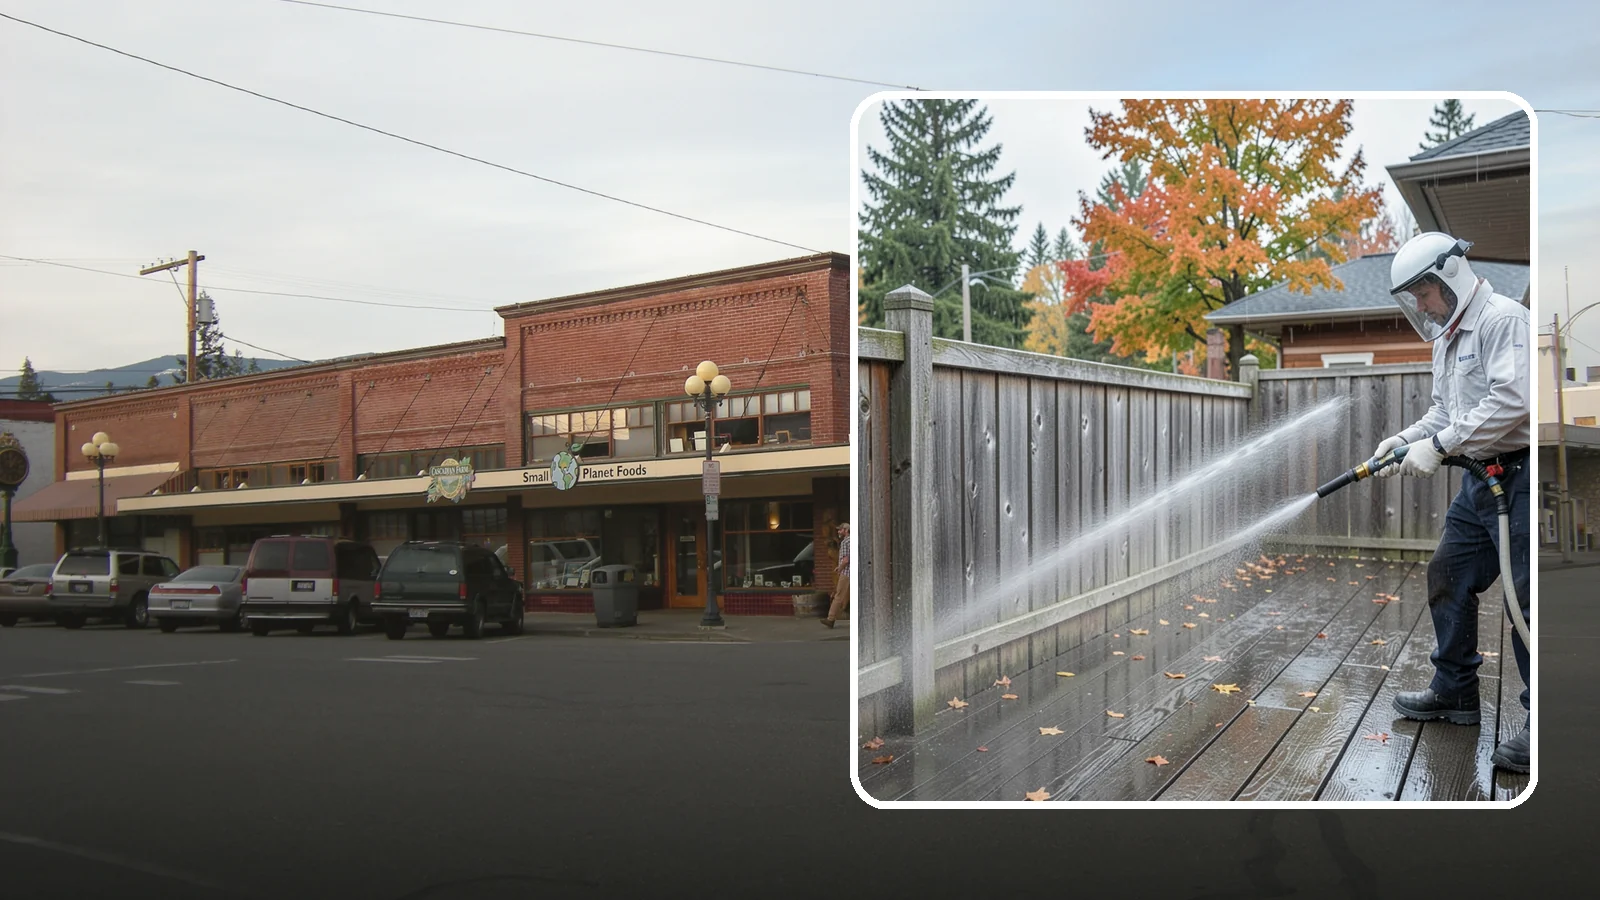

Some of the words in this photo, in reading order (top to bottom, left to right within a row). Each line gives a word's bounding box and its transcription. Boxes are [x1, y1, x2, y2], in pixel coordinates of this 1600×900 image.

[523, 471, 549, 483] Small
[582, 467, 614, 479] Planet
[616, 464, 647, 477] Foods
